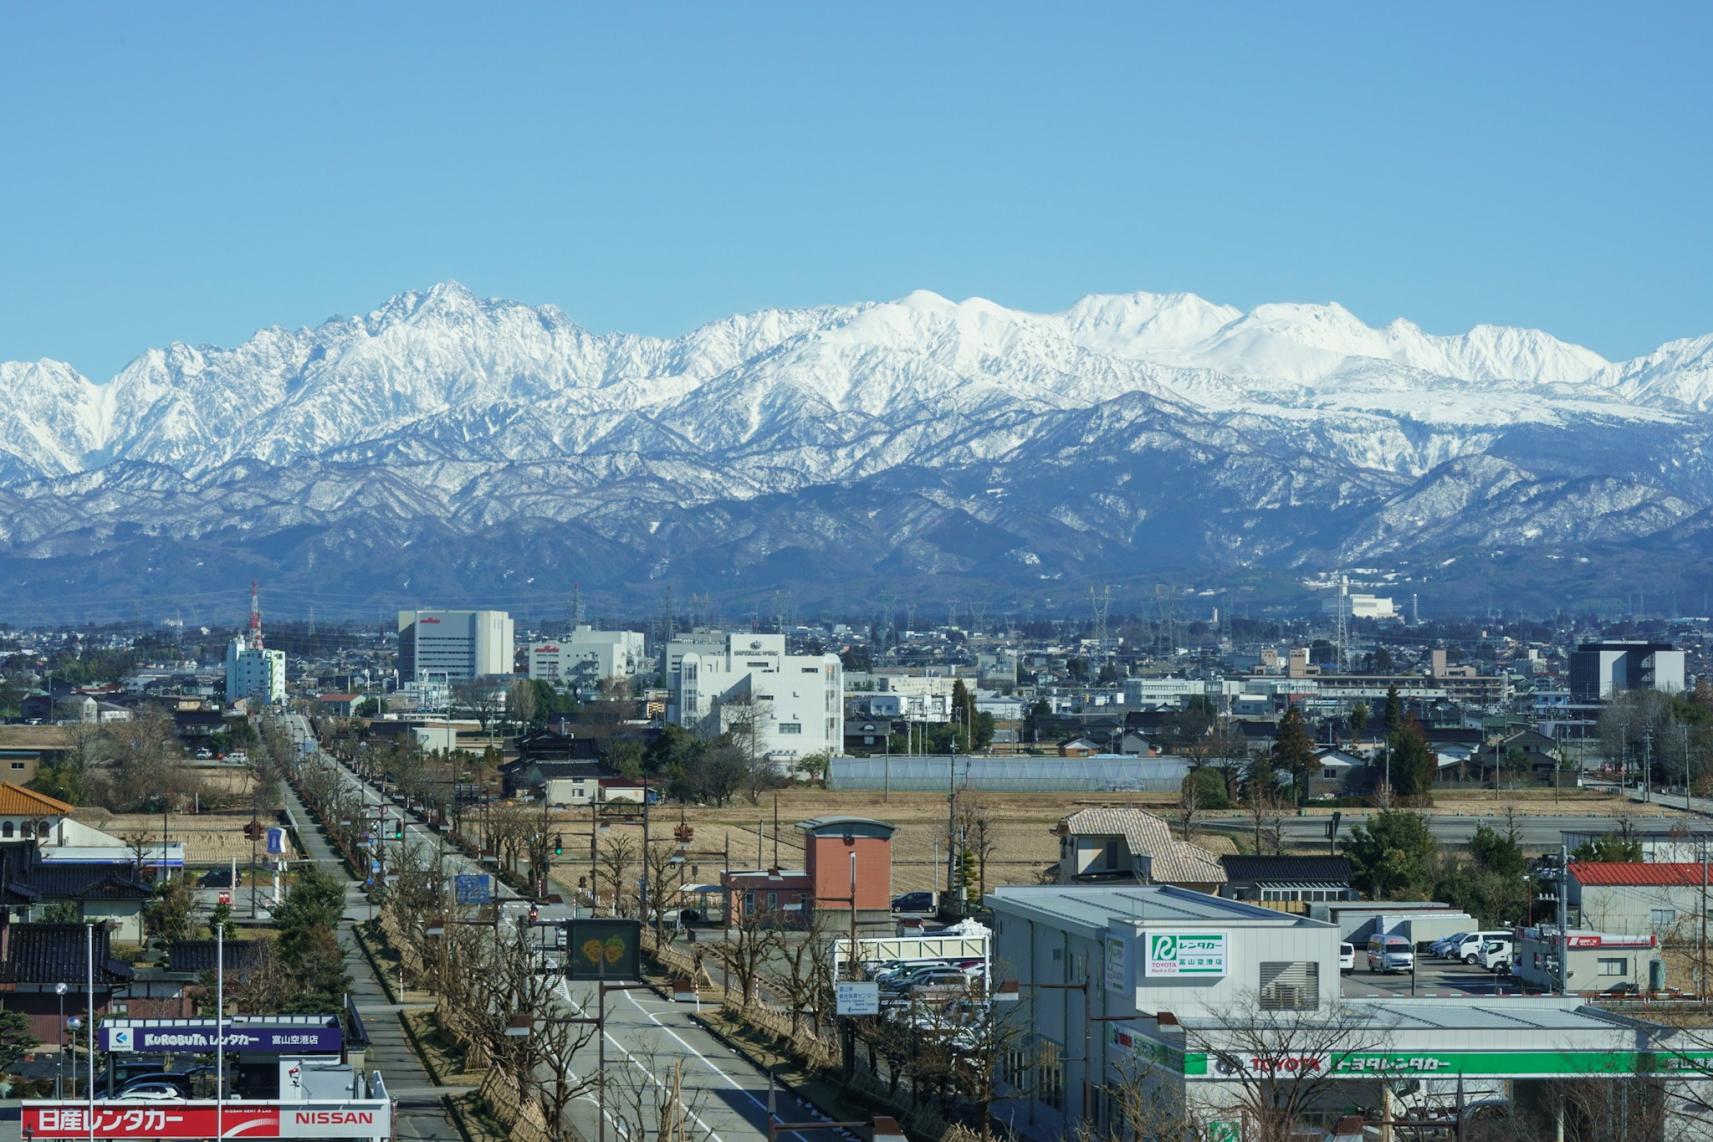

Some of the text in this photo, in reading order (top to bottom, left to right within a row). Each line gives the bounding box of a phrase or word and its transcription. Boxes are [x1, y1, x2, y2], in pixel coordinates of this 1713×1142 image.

[209, 1034, 260, 1046] レンタカー
[272, 1034, 319, 1045] 富山空港店
[1252, 1056, 1320, 1072] TOYOTA
[1336, 1057, 1451, 1071] トヨタレンタカー
[39, 1108, 184, 1132] 日産レンタカー
[295, 1112, 373, 1125] NISSAN
